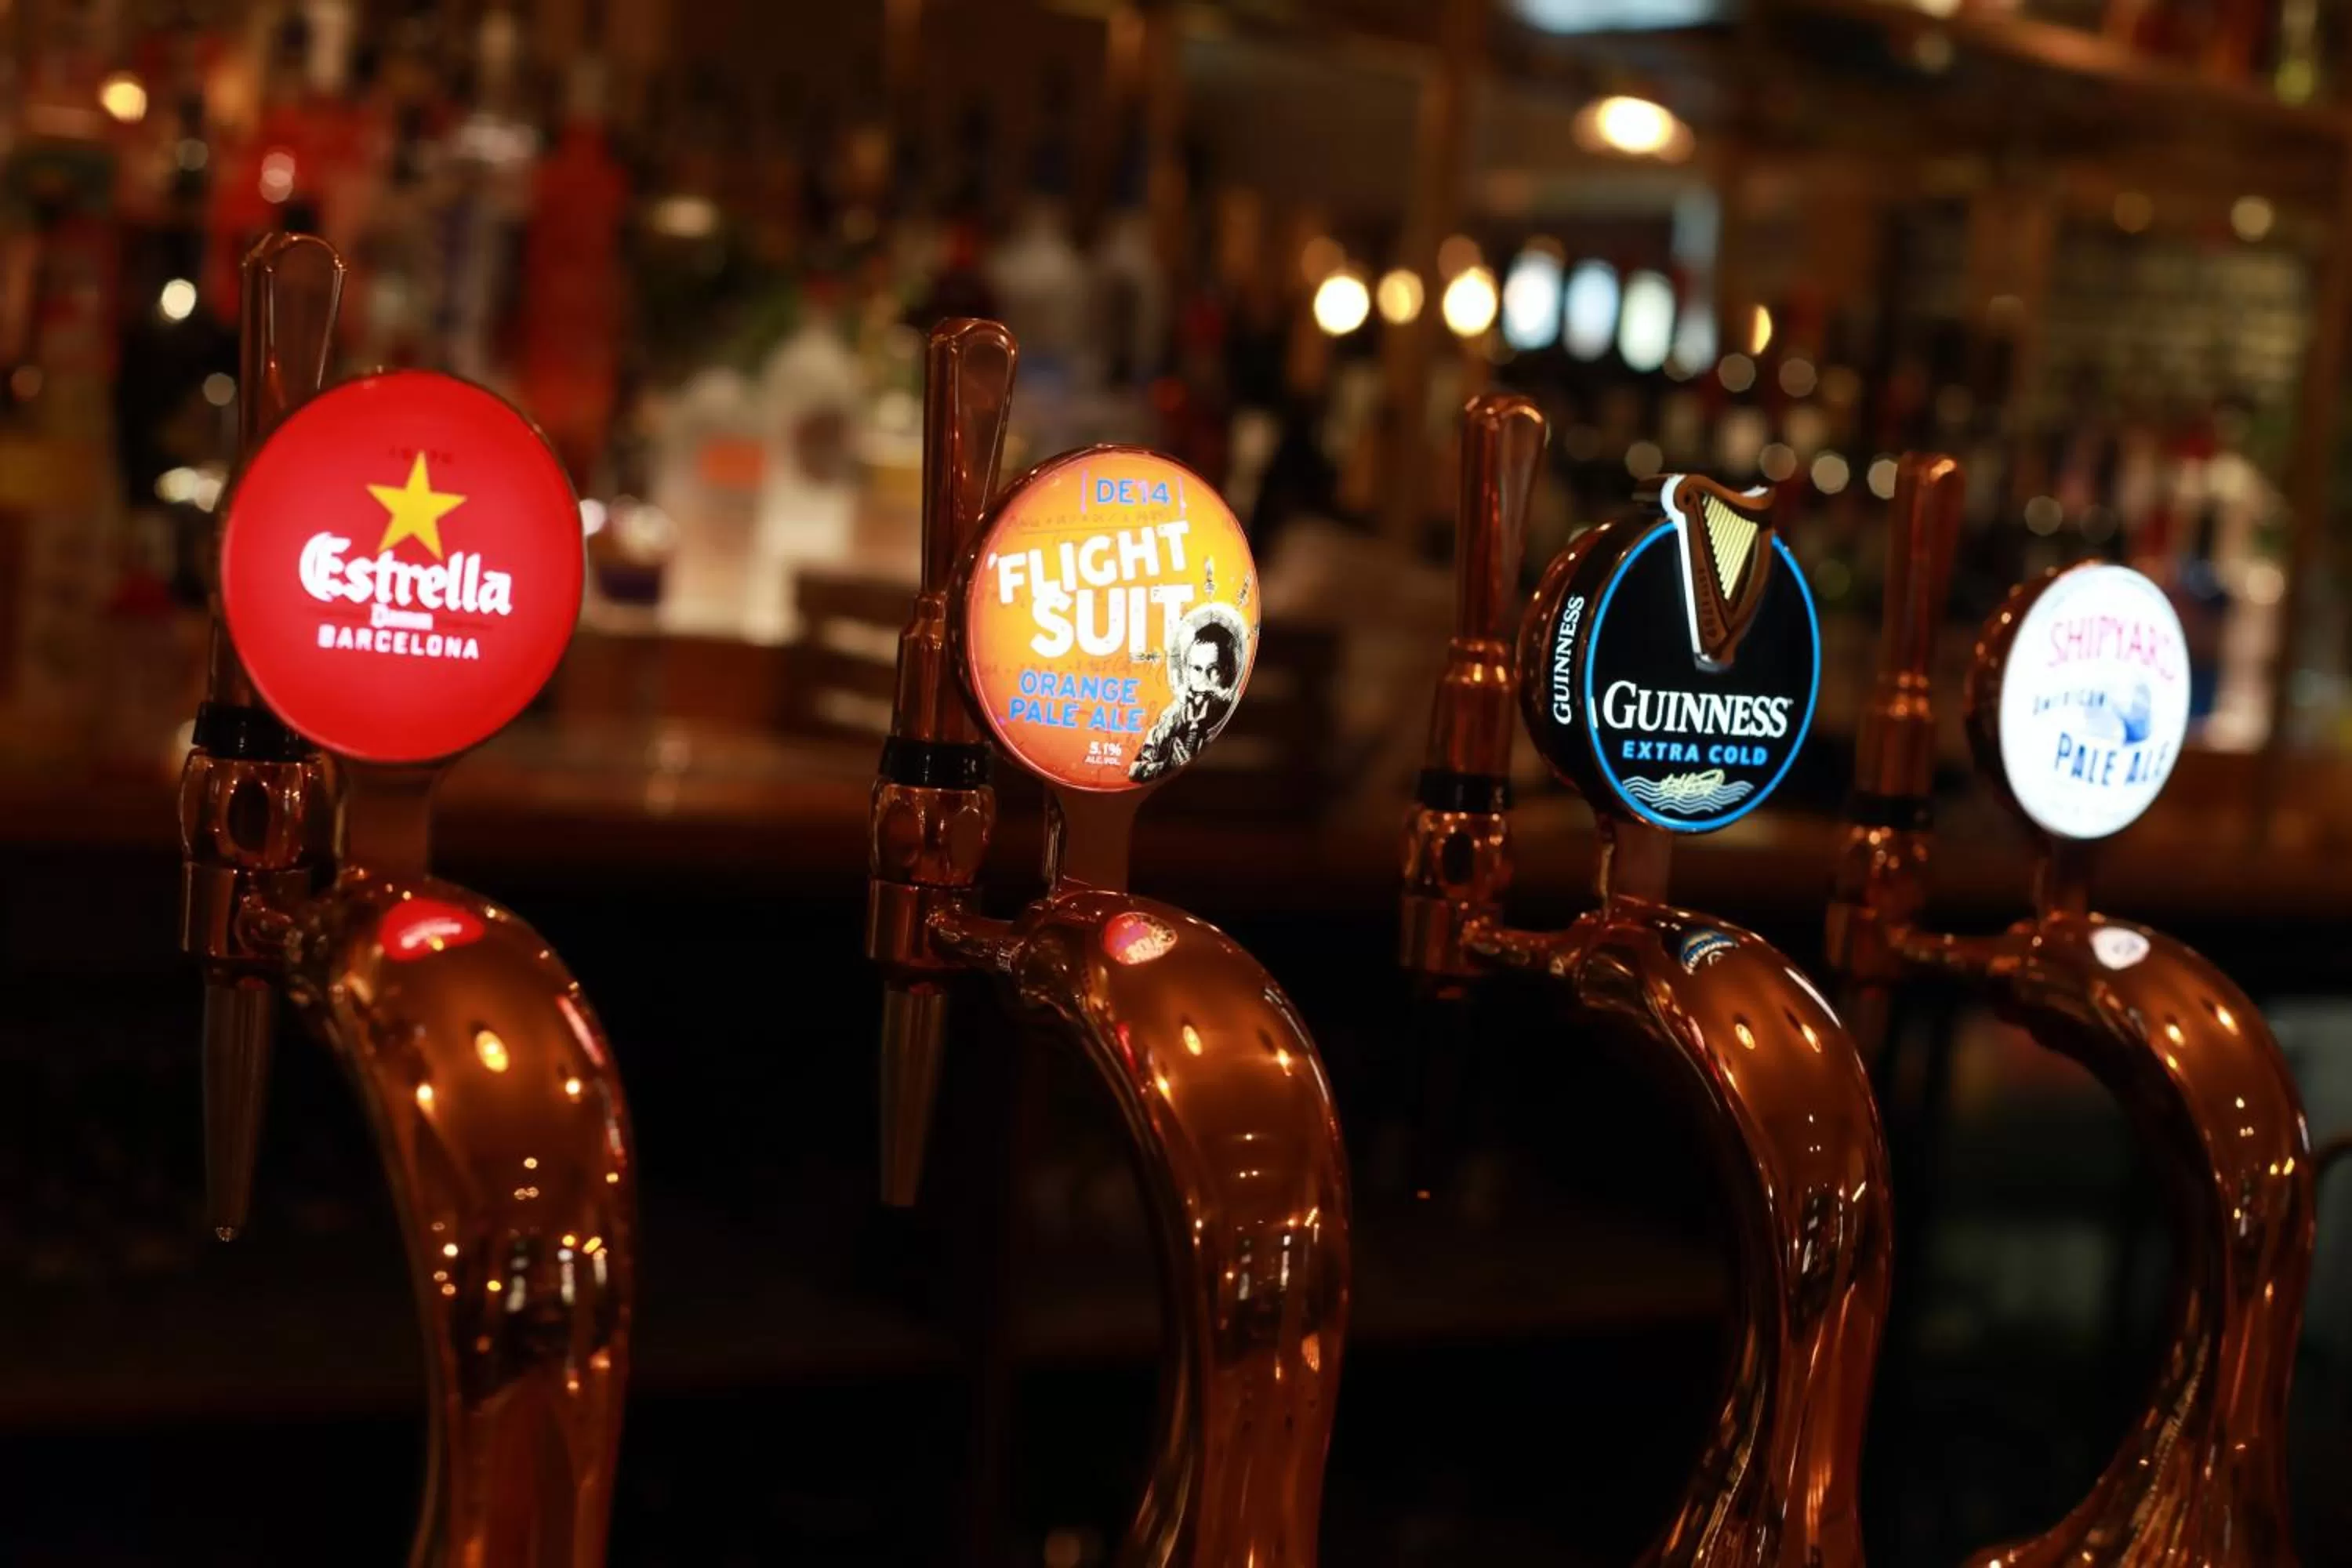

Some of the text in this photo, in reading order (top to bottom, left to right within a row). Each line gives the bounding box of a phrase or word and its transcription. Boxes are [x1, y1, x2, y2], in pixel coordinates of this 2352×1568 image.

[1096, 477, 1172, 506] DE14
[299, 532, 513, 615] Estrella
[317, 625, 479, 660] BARCELONA
[1029, 583, 1195, 659] SUIT
[1553, 594, 1585, 726] GUINNESS
[1020, 670, 1142, 704] ORANGE
[1602, 680, 1788, 739] GUINNESS
[1009, 697, 1145, 733] PALE ALE
[1622, 739, 1769, 766] EXTRA COLD
[2055, 731, 2118, 786] PALE
